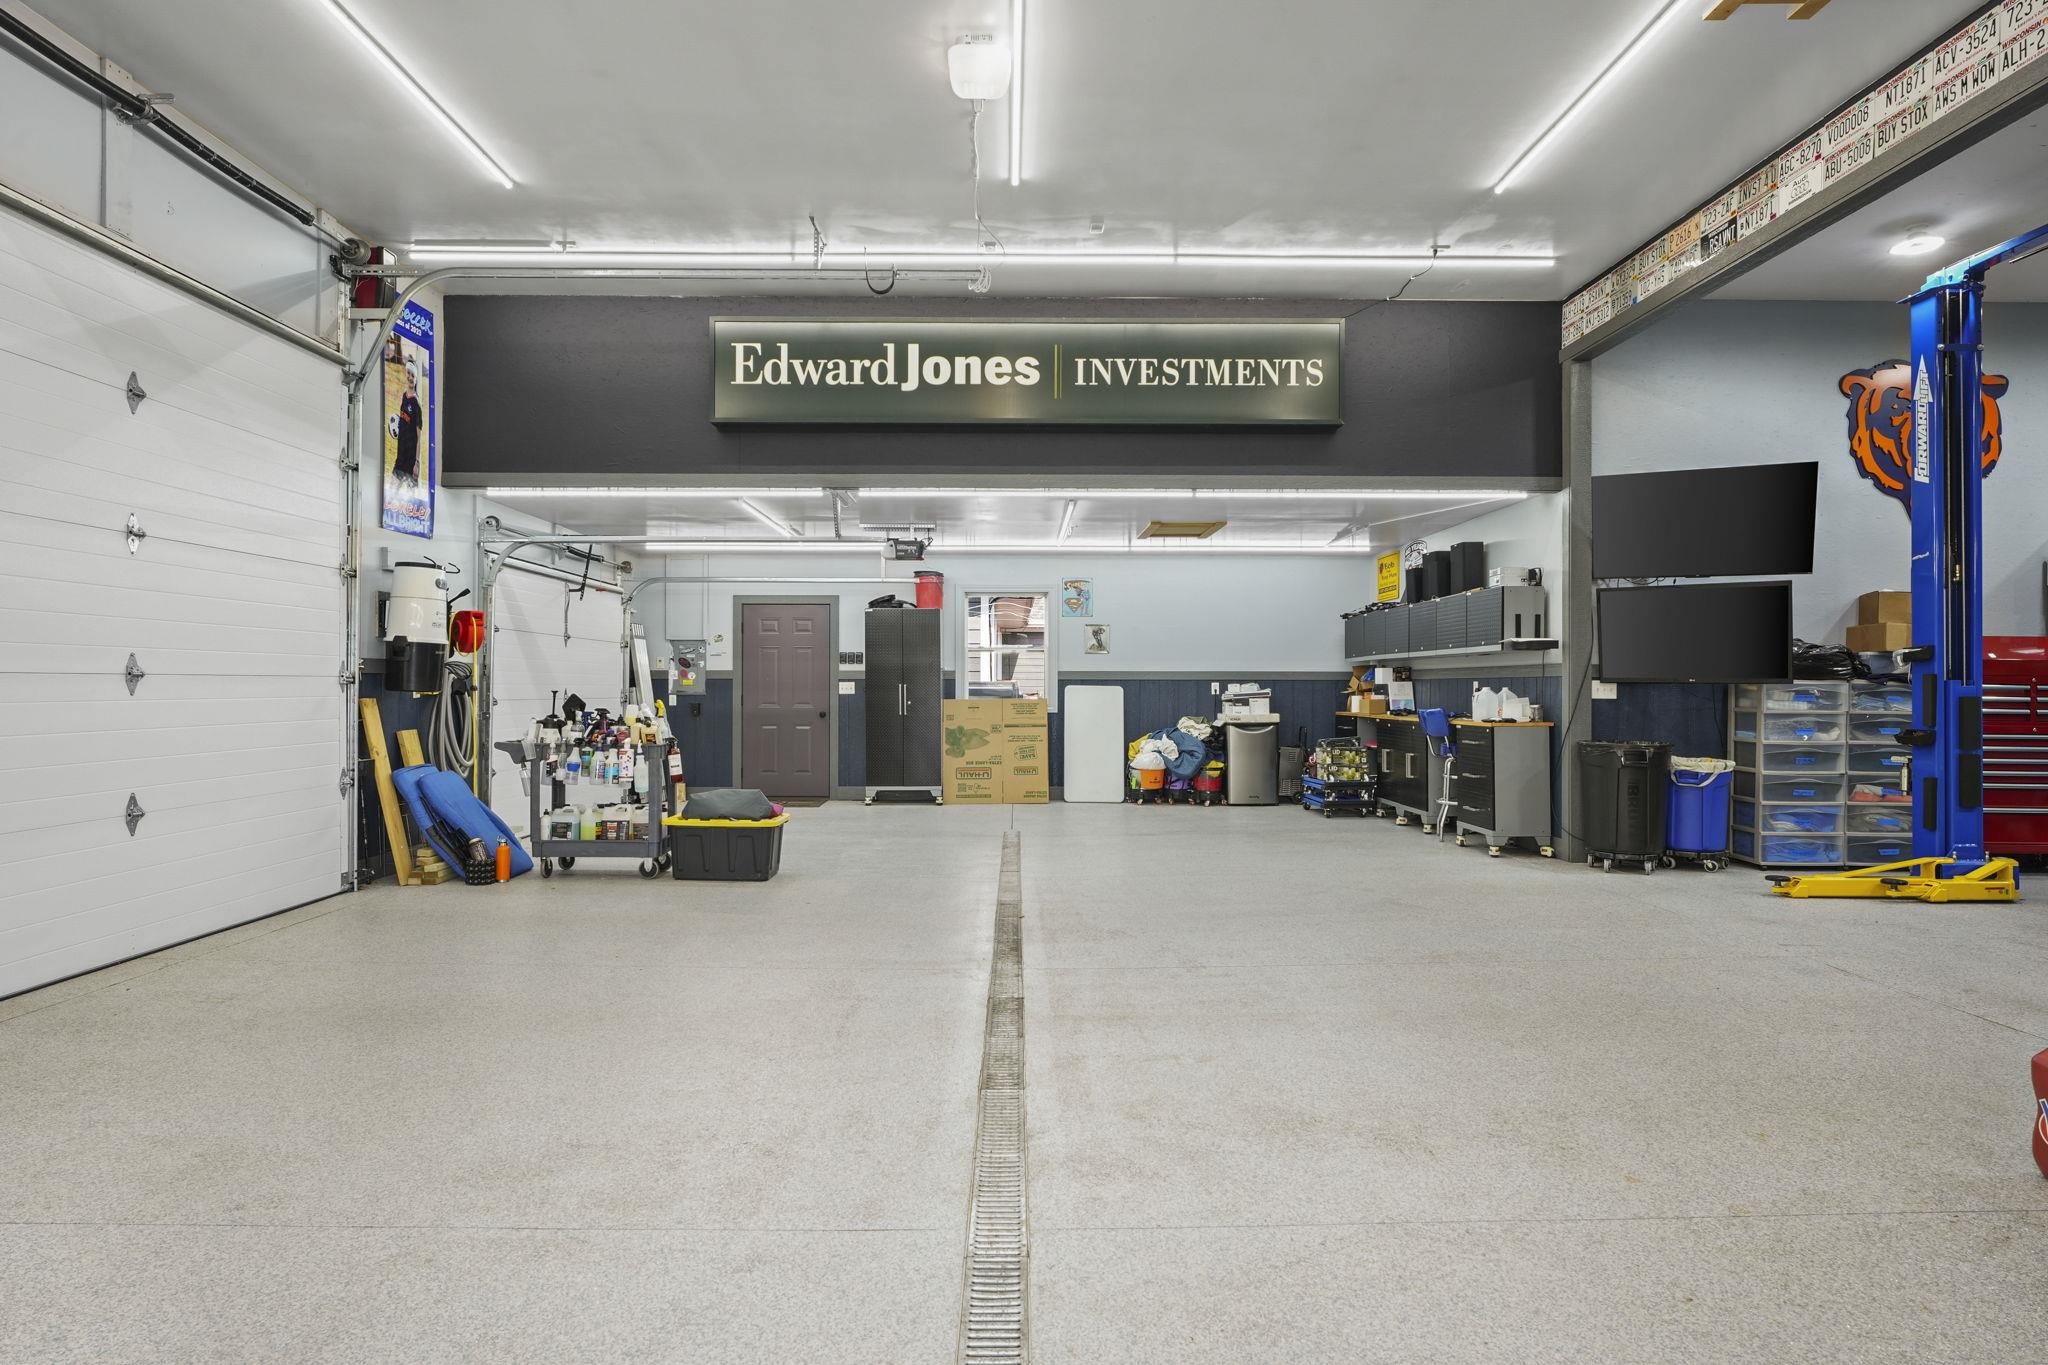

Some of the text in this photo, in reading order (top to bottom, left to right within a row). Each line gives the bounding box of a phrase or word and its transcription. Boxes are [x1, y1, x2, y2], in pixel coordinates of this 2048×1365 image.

[1935, 27, 1970, 56] WISCONSIN
[1935, 18, 1996, 76] ACV-3524
[2002, 19, 2042, 49] WISCONSIN
[1876, 69, 1907, 96] WISCONSIN
[1885, 67, 1926, 108] NT1871
[1935, 65, 1970, 93] WISCONSIN
[1935, 83, 1957, 112] AWS
[1972, 58, 1996, 90] WOW
[1876, 106, 1907, 131] WISCONSIN
[1877, 121, 1897, 148] BUY
[1900, 101, 1928, 134] STOX
[1780, 138, 1822, 178] AGC-8270
[1825, 138, 1871, 181] ABU-5008
[1792, 173, 1809, 187] Audi
[1745, 200, 1773, 231] NT1871
[1675, 225, 1692, 247] 2616
[1074, 358, 1325, 387] INVESTMENTS
